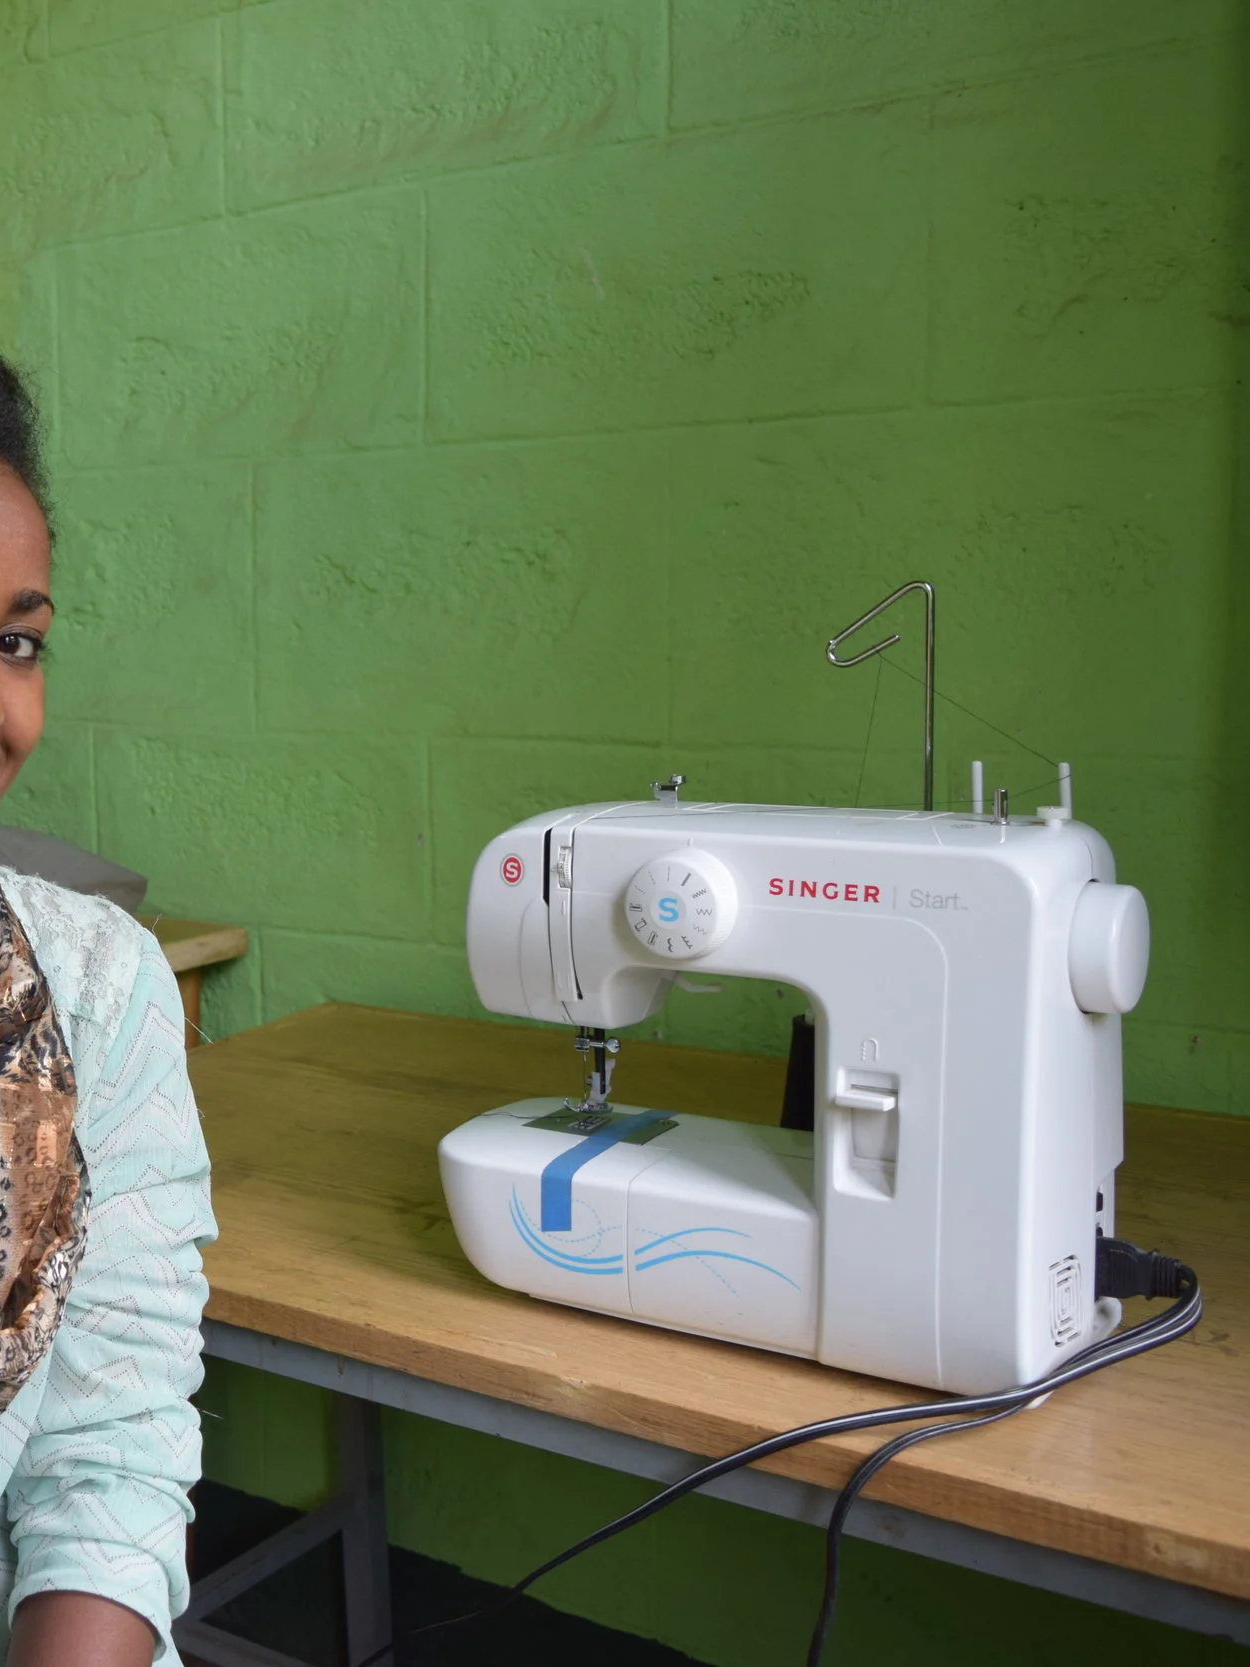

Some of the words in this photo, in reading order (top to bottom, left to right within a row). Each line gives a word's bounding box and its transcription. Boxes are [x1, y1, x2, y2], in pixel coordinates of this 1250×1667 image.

[768, 877, 881, 904] SINGER
[909, 888, 960, 911] Start
[658, 897, 680, 923] S
